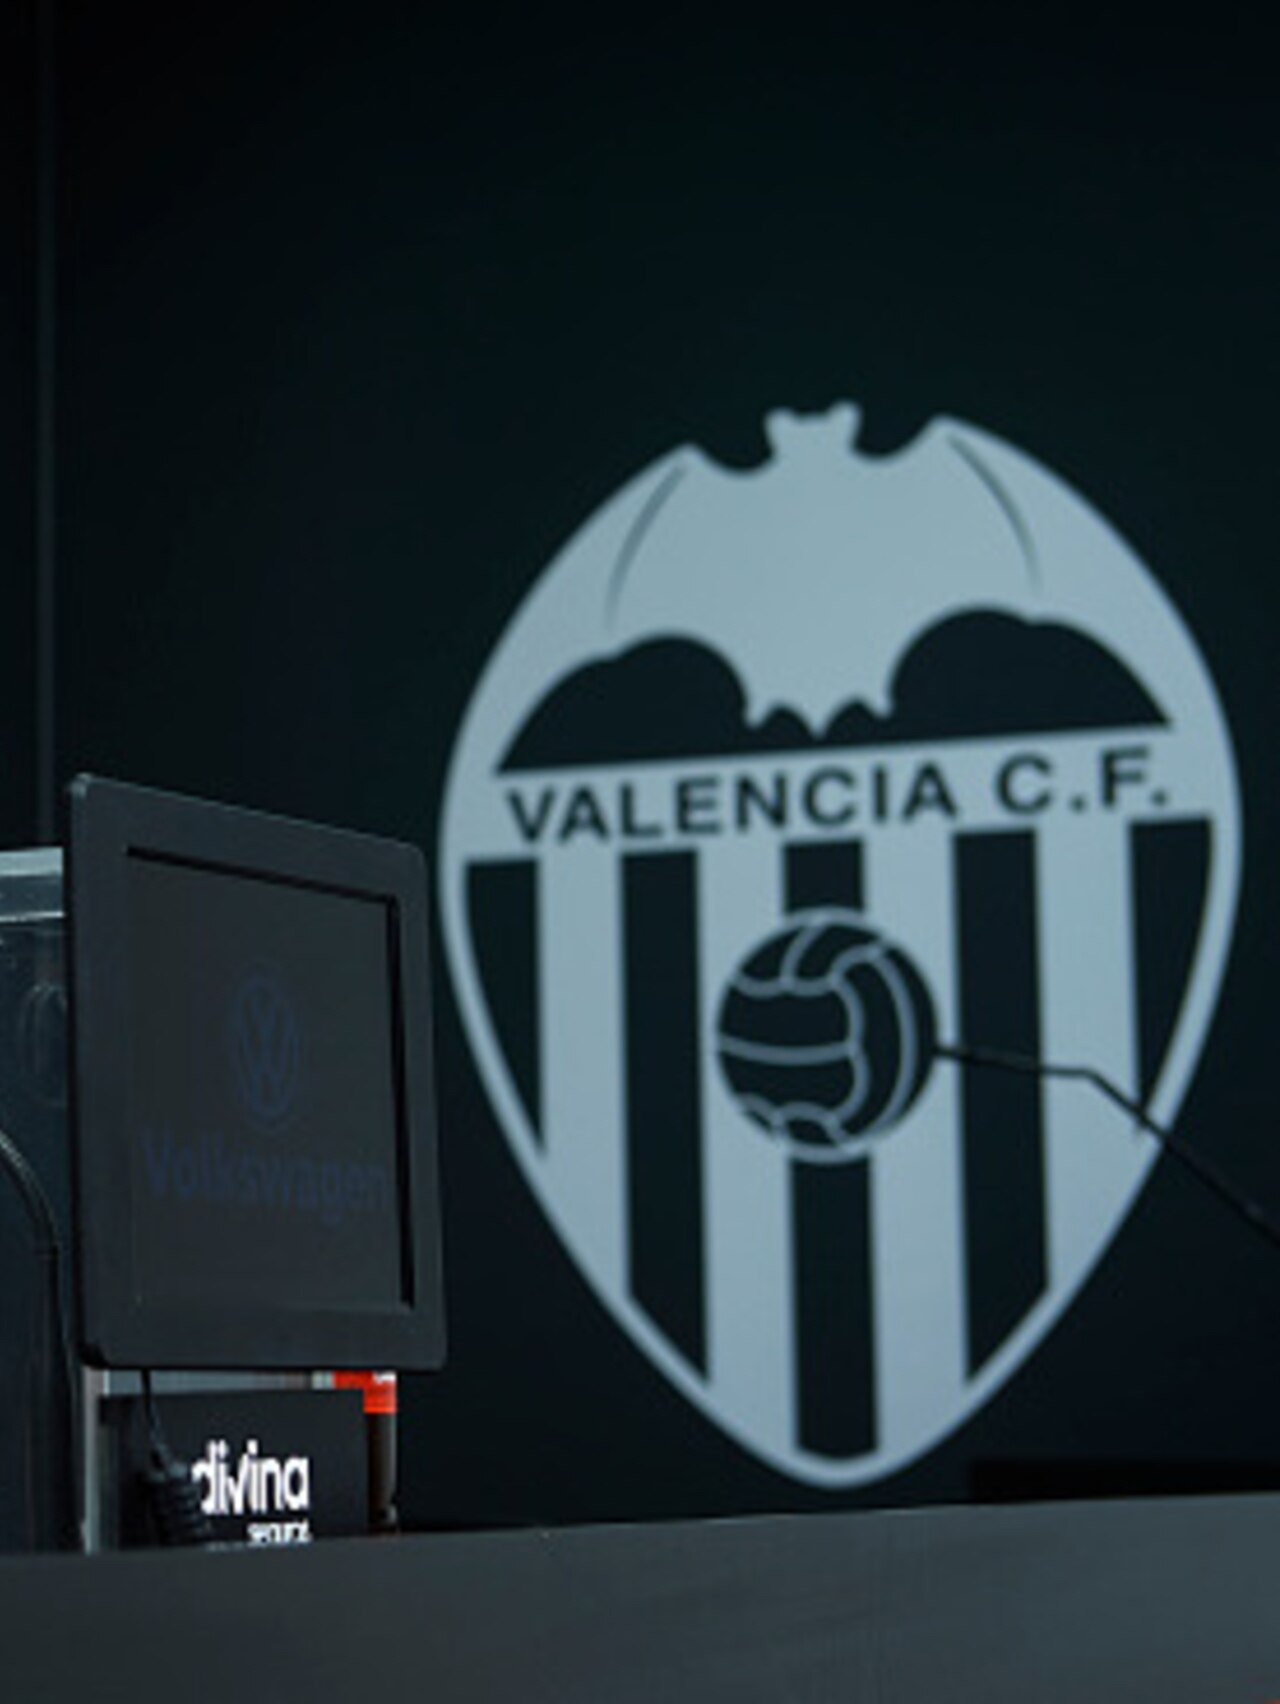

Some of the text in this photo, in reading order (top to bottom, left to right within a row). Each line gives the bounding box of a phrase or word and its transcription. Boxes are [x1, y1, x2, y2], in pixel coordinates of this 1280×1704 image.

[506, 746, 1170, 844] VALENCIA C.F.
[190, 1437, 311, 1517] divina
